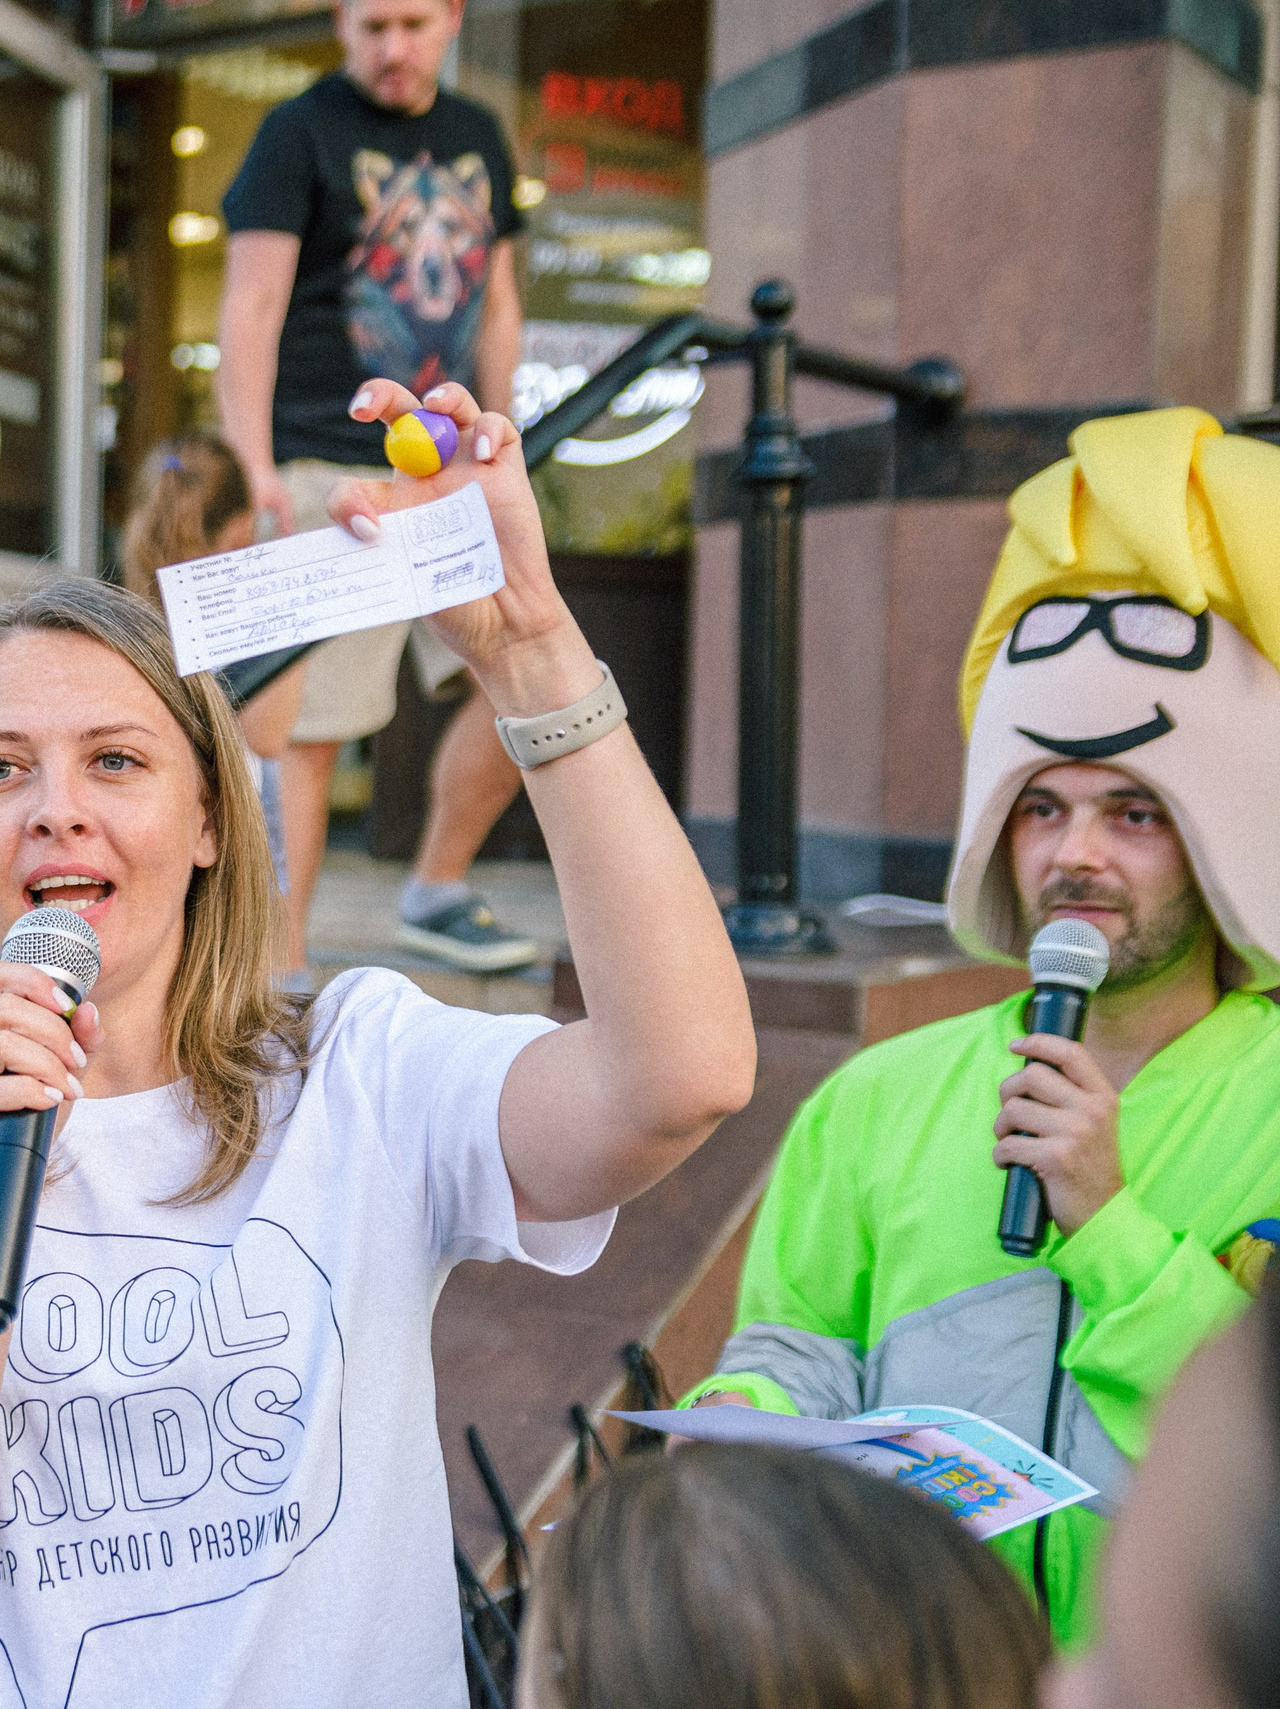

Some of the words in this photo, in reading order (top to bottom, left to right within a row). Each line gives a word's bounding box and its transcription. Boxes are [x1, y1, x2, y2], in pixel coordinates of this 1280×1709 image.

[213, 587, 237, 597] номер
[240, 620, 266, 631] Вашего
[7, 1250, 290, 1384] OOL
[37, 1530, 174, 1591] ДЕТСКОГО
[189, 1501, 301, 1563] РАЗВИТИЯ
